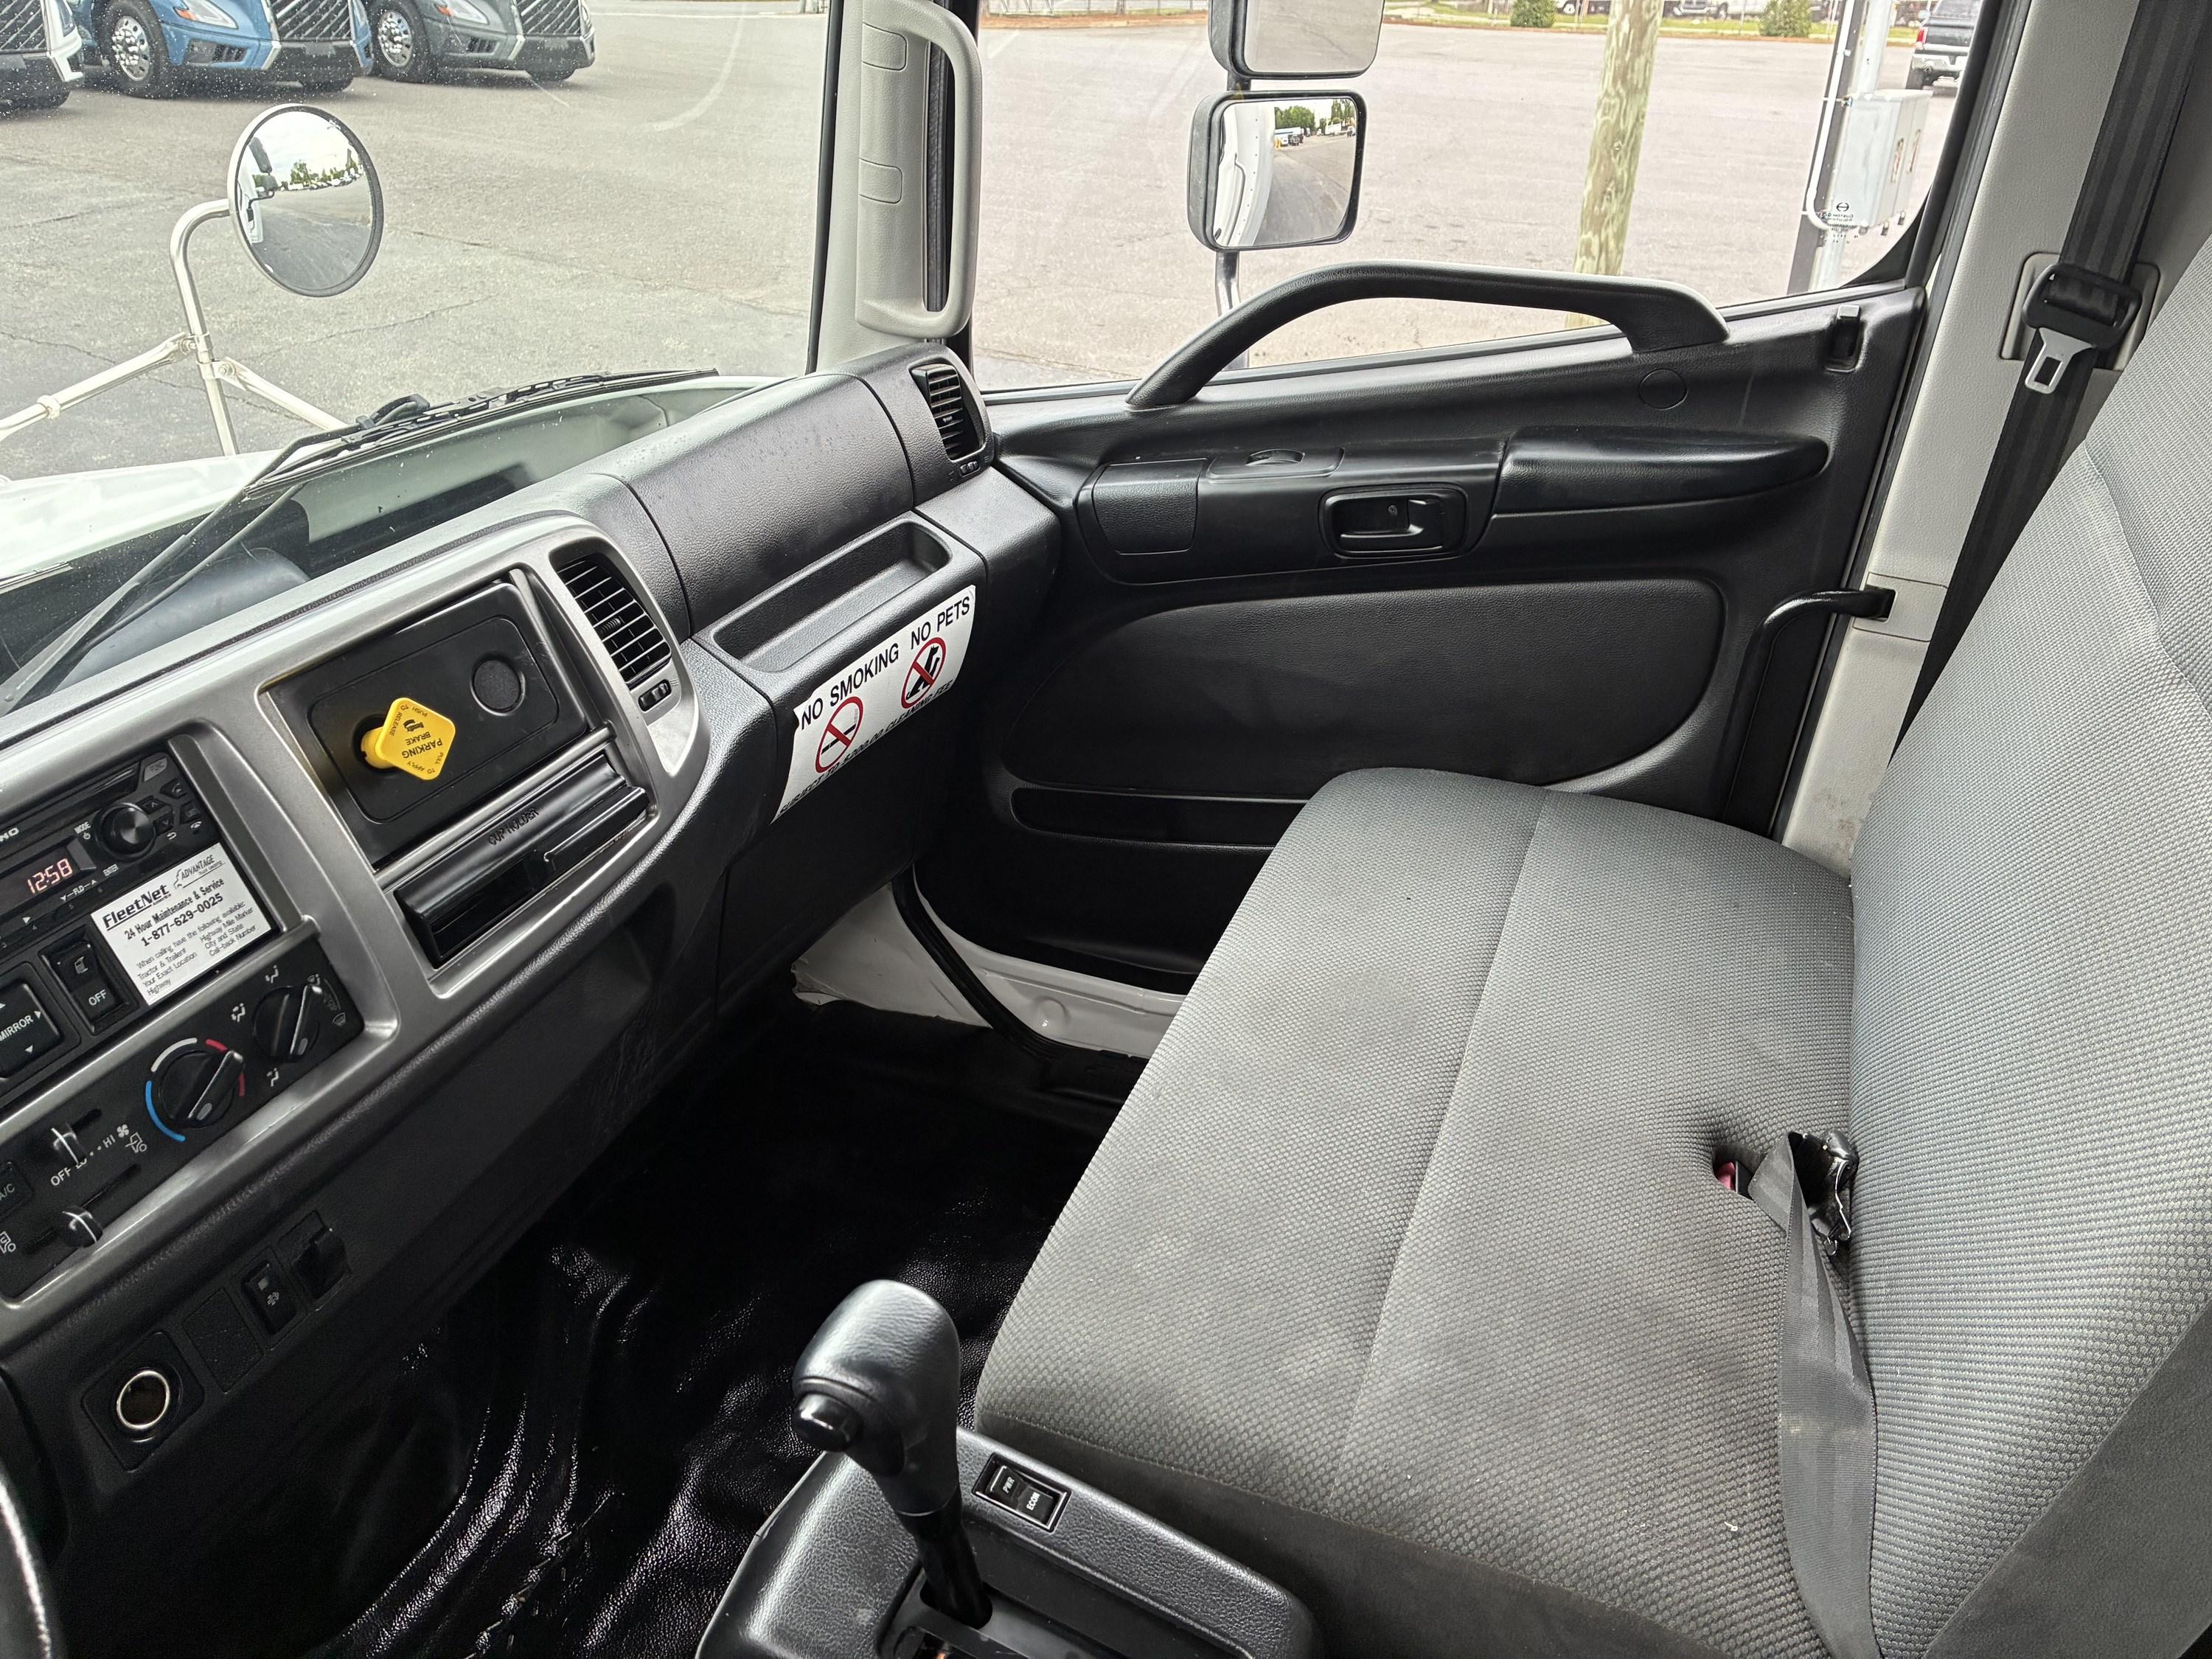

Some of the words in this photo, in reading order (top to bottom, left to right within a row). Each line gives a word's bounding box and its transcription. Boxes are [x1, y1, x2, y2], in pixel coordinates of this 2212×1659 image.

[910, 622, 931, 650] NO
[937, 596, 970, 632] PETS
[801, 698, 824, 730] NO
[830, 642, 900, 707] SMOKING
[405, 731, 431, 745] BRAKE
[827, 762, 840, 775] TO
[933, 679, 953, 696] FEE
[401, 737, 443, 759] PARKING
[488, 828, 505, 846] CUP
[507, 807, 540, 835] HOLDER
[27, 858, 73, 894] 12:58
[181, 854, 215, 880] ADVANTAGE
[102, 884, 170, 928] FleetNet
[124, 928, 136, 940] 24
[135, 919, 153, 933] Hour
[152, 897, 193, 924] Maintenance
[192, 891, 201, 900] &
[199, 878, 224, 895] Service
[141, 893, 223, 947] 1-877-629-0025
[136, 956, 155, 969] When
[155, 945, 174, 958] calling
[173, 936, 187, 947] have
[187, 929, 198, 939] the
[197, 916, 223, 933] following
[199, 926, 223, 942] Highway
[204, 939, 217, 950] City
[218, 931, 228, 942] and
[227, 923, 244, 936] State
[209, 937, 236, 956] Call-back
[234, 925, 257, 941] Number
[138, 965, 158, 980] Tractor
[142, 976, 156, 987] Your
[156, 966, 174, 979] Exact
[173, 951, 198, 969] Location
[88, 990, 107, 1006] OFF
[147, 978, 172, 995] Highway
[0, 1015, 34, 1042] MIRROR
[50, 1167, 72, 1186] OFF
[102, 1134, 116, 1148] HI
[1002, 1476, 1015, 1494] PWR
[1026, 1492, 1040, 1511] ECON
